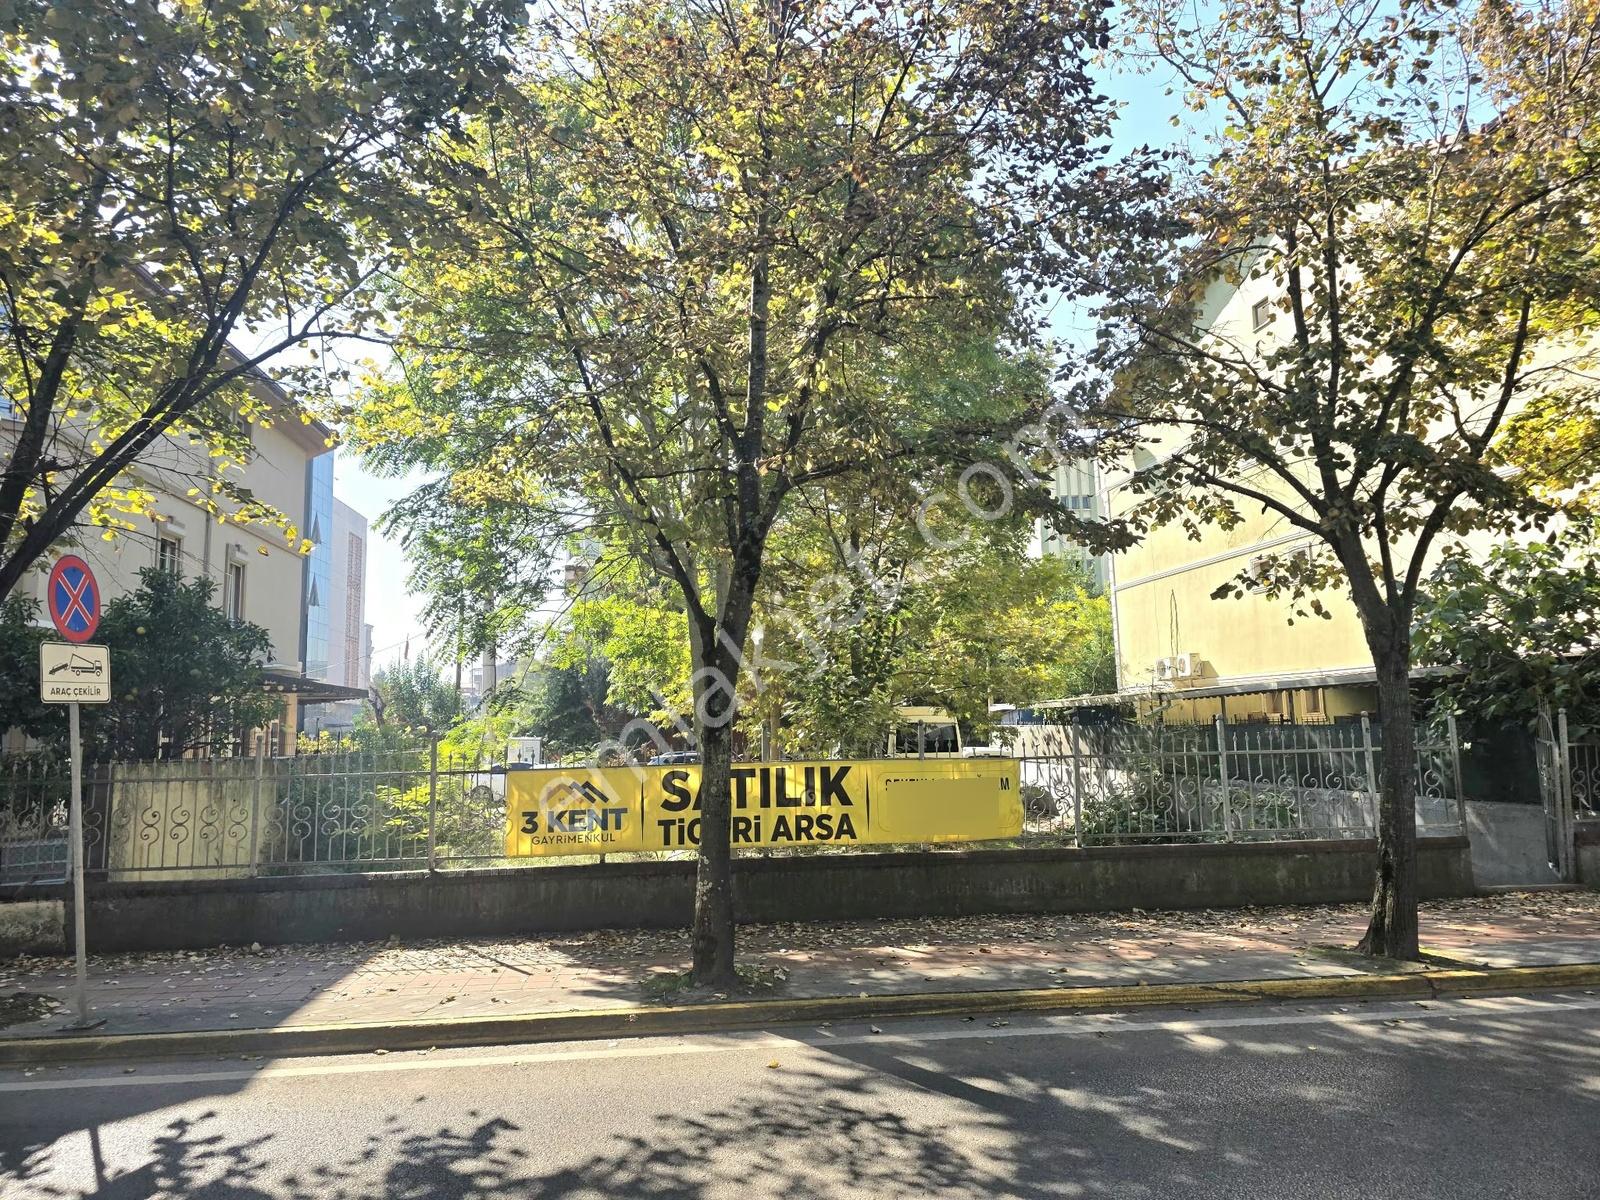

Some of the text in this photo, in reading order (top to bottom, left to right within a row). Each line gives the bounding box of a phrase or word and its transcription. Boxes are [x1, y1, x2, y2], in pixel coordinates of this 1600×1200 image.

[50, 685, 101, 697] ARAÇ ÇEKİLİR
[661, 766, 853, 812] STILIK
[521, 808, 628, 834] 3 KENT
[771, 813, 857, 841] ARSA
